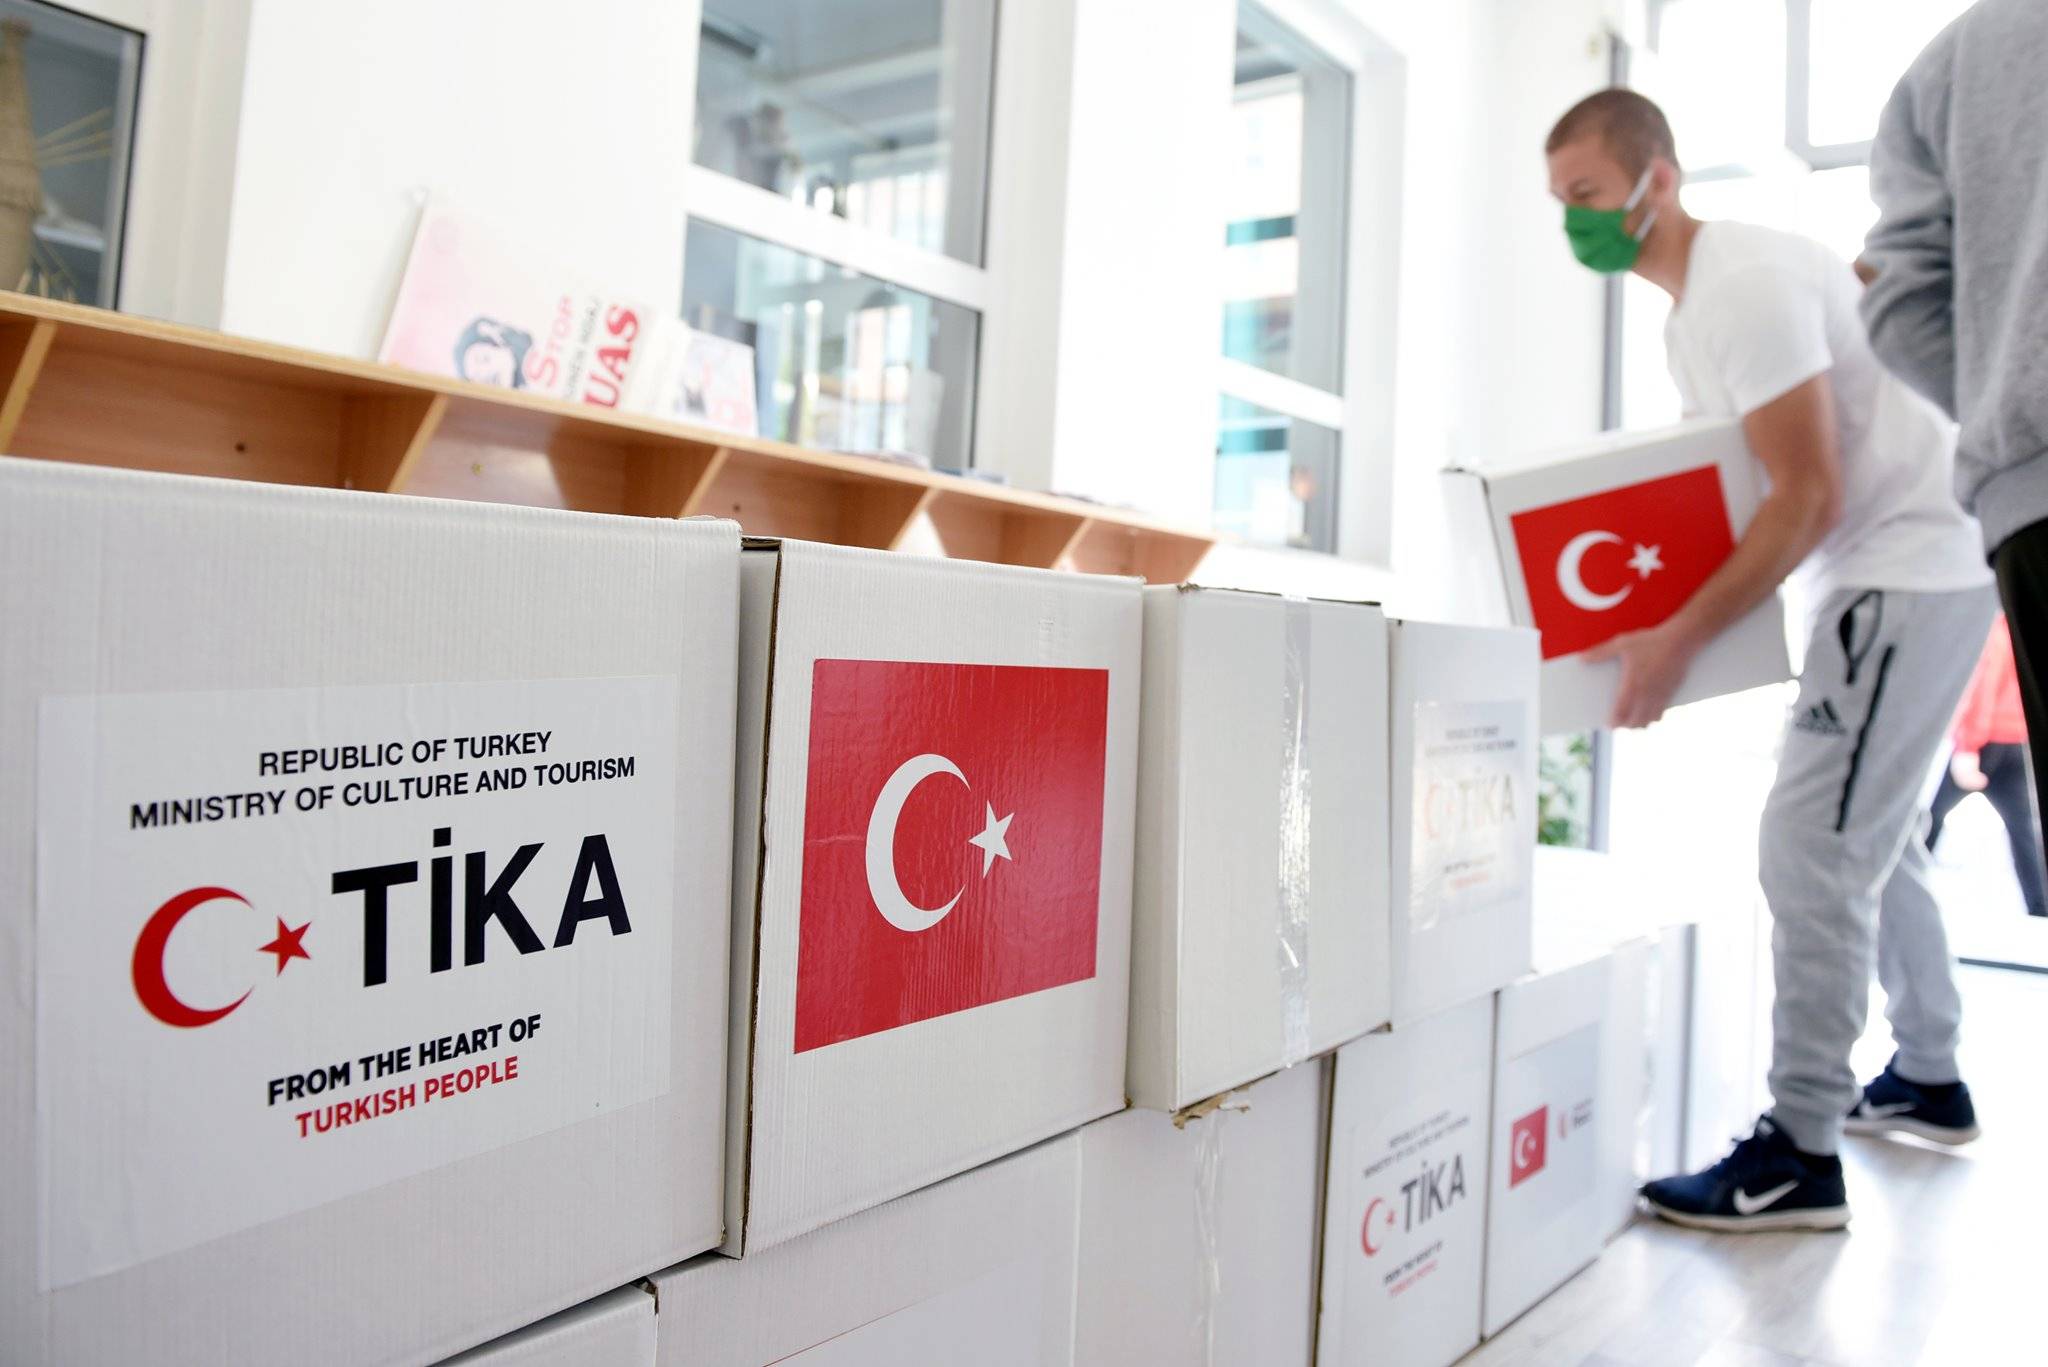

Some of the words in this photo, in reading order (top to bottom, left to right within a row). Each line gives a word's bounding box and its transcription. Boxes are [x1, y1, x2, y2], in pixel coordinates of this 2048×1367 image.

[130, 789, 287, 830] MINISTRY
[295, 785, 335, 812] OF
[342, 771, 470, 807] CULTURE
[475, 766, 528, 794] AND
[533, 756, 636, 788] TOURISM
[258, 742, 404, 777] REPUBLIC
[411, 739, 448, 764] OF
[453, 731, 553, 760] TURKEY
[331, 826, 633, 988] TİKA
[267, 1061, 351, 1107] FROM
[358, 1045, 412, 1082] THE
[417, 1023, 504, 1067] HEART
[508, 1013, 542, 1043] OF
[295, 1083, 417, 1139] TURKISH
[423, 1055, 519, 1104] PEOPLE
